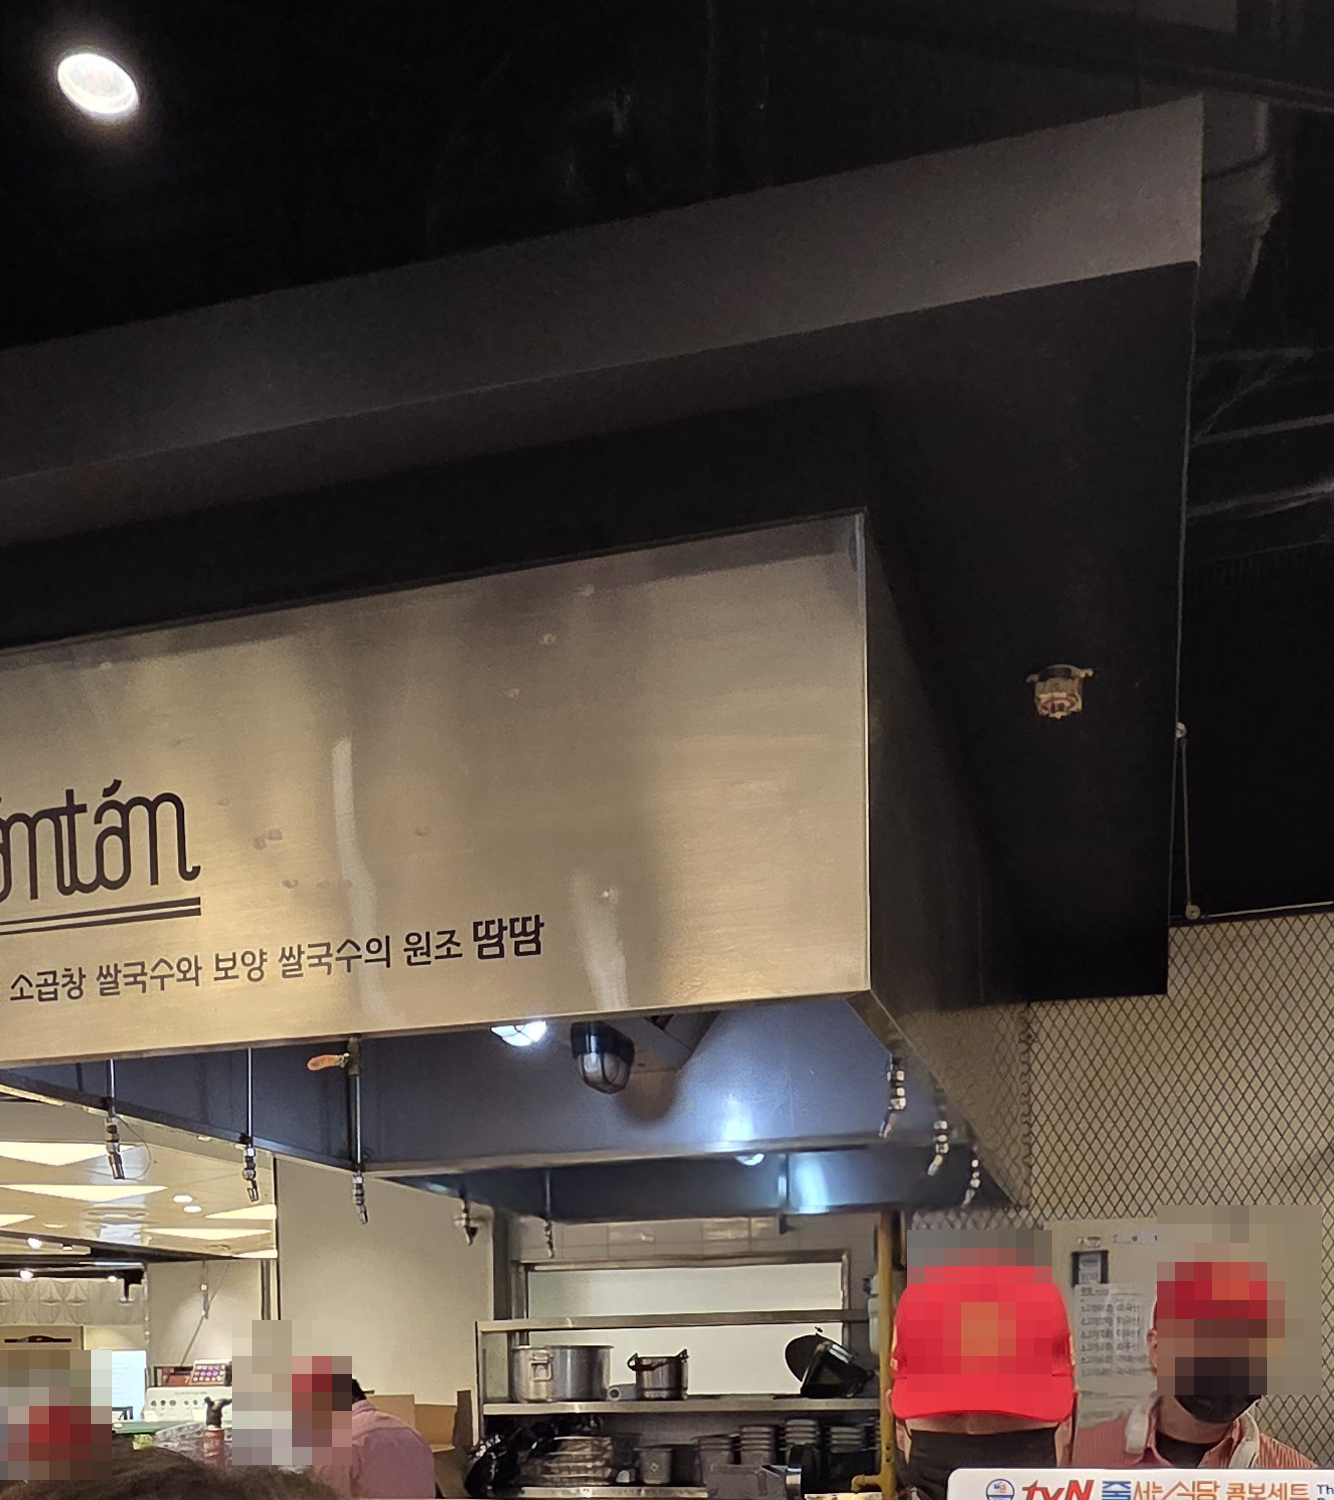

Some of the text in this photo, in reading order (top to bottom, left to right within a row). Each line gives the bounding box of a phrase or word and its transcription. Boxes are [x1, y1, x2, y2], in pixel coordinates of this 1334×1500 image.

[10, 967, 86, 1001] 소곱창
[96, 958, 203, 996] 쌀국수와
[214, 951, 266, 983] 보양
[278, 935, 391, 978] 쌀국수의
[403, 929, 462, 966] 원조
[472, 914, 544, 958] 땀땀
